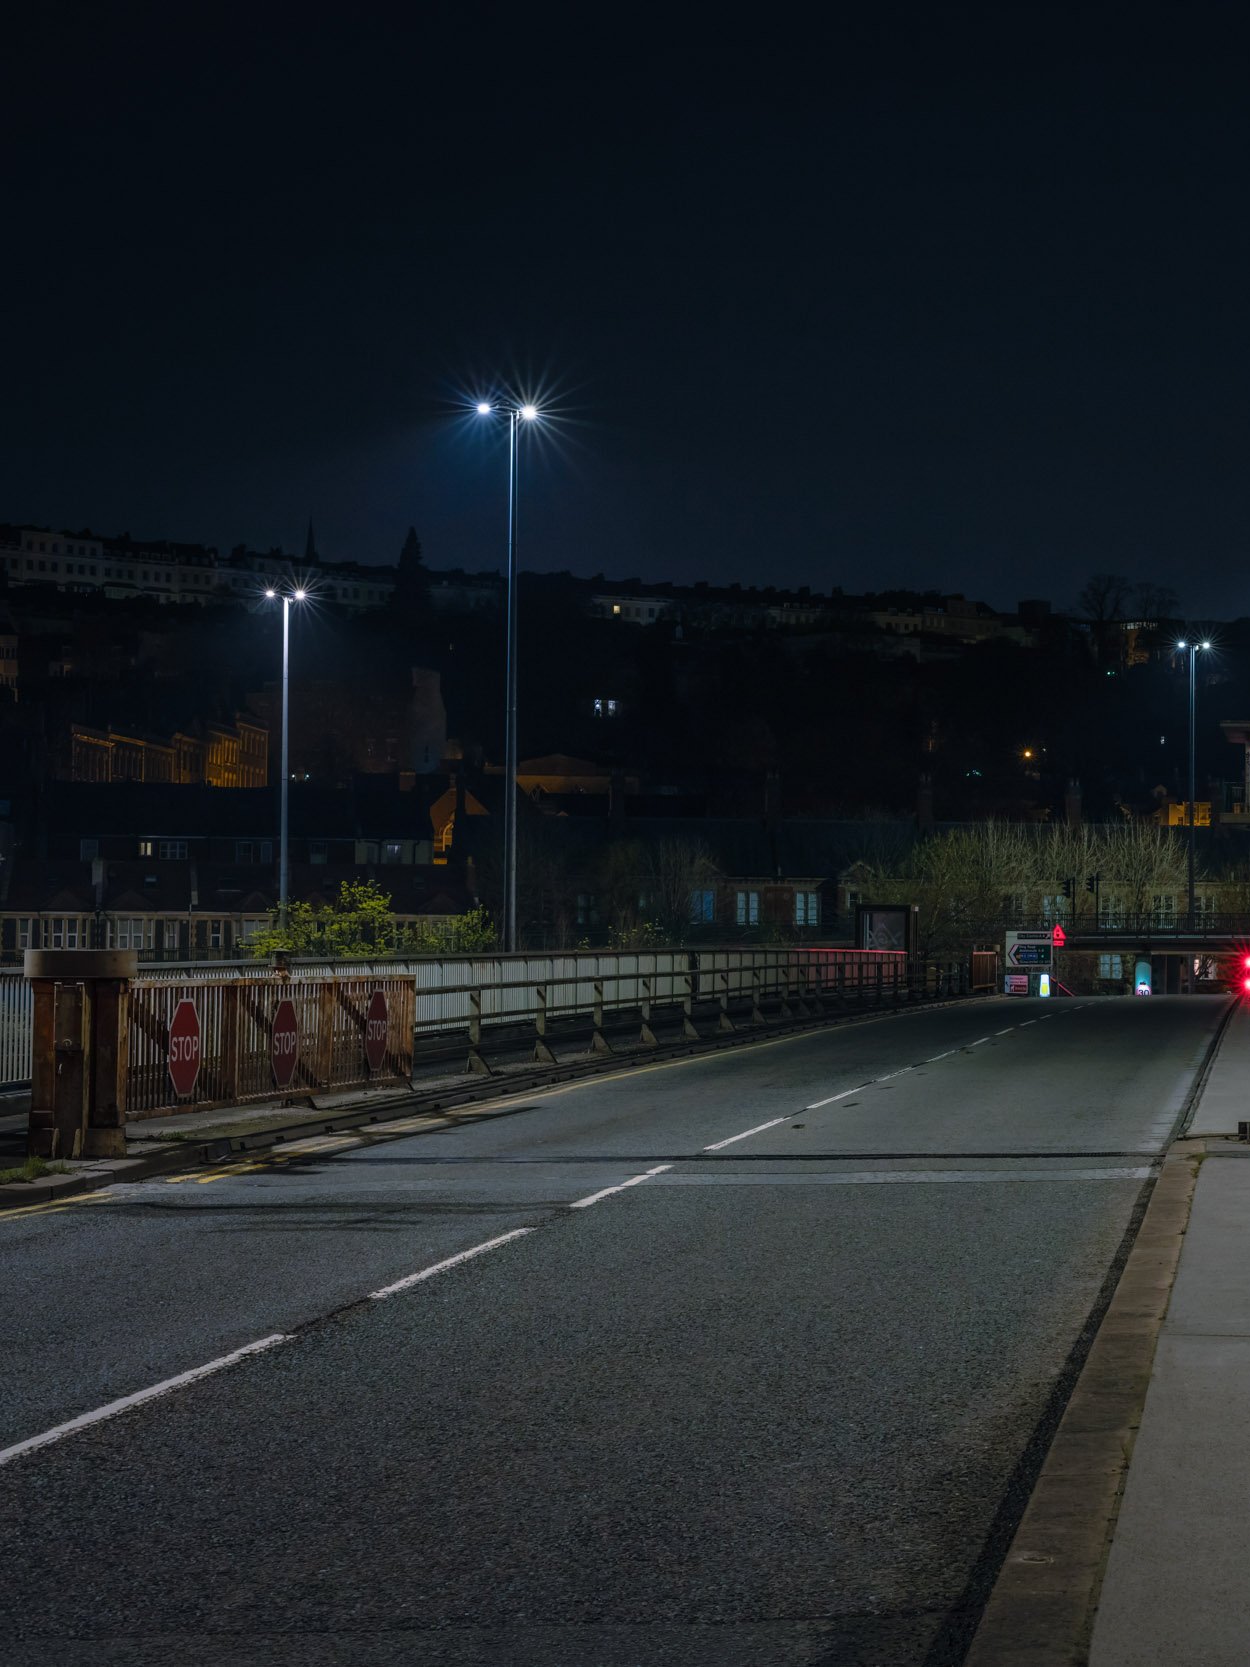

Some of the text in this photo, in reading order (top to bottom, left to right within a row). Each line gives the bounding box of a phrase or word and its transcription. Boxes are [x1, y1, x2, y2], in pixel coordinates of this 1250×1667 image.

[368, 1020, 386, 1040] STOP
[171, 1036, 199, 1061] STOP
[274, 1032, 295, 1055] STOP
